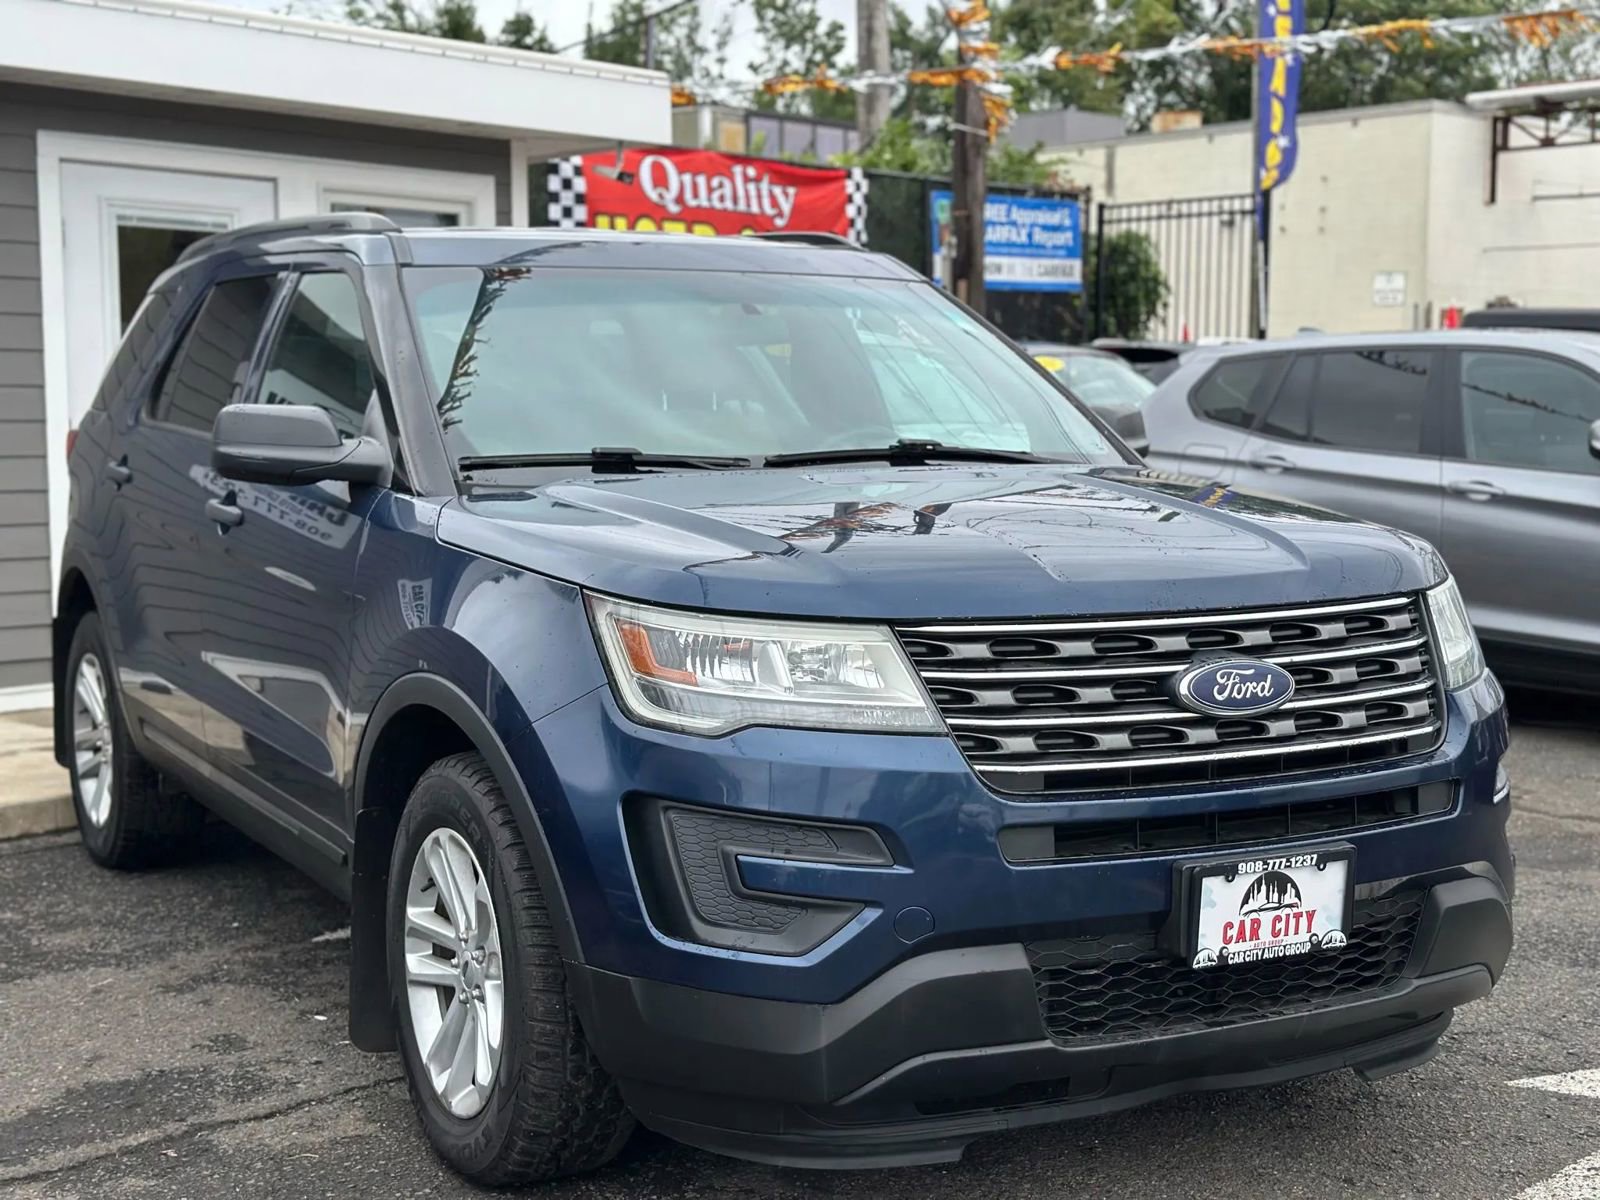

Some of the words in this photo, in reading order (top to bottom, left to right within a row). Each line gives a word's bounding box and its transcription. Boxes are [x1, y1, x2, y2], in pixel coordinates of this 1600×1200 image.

[638, 154, 797, 227] Quality
[1213, 669, 1274, 701] Ford
[1237, 854, 1318, 874] 908-777-1237
[1222, 917, 1262, 945] CAR
[1271, 909, 1317, 938] CITY
[1263, 945, 1285, 959] AUTO
[1285, 942, 1311, 956] GROUP
